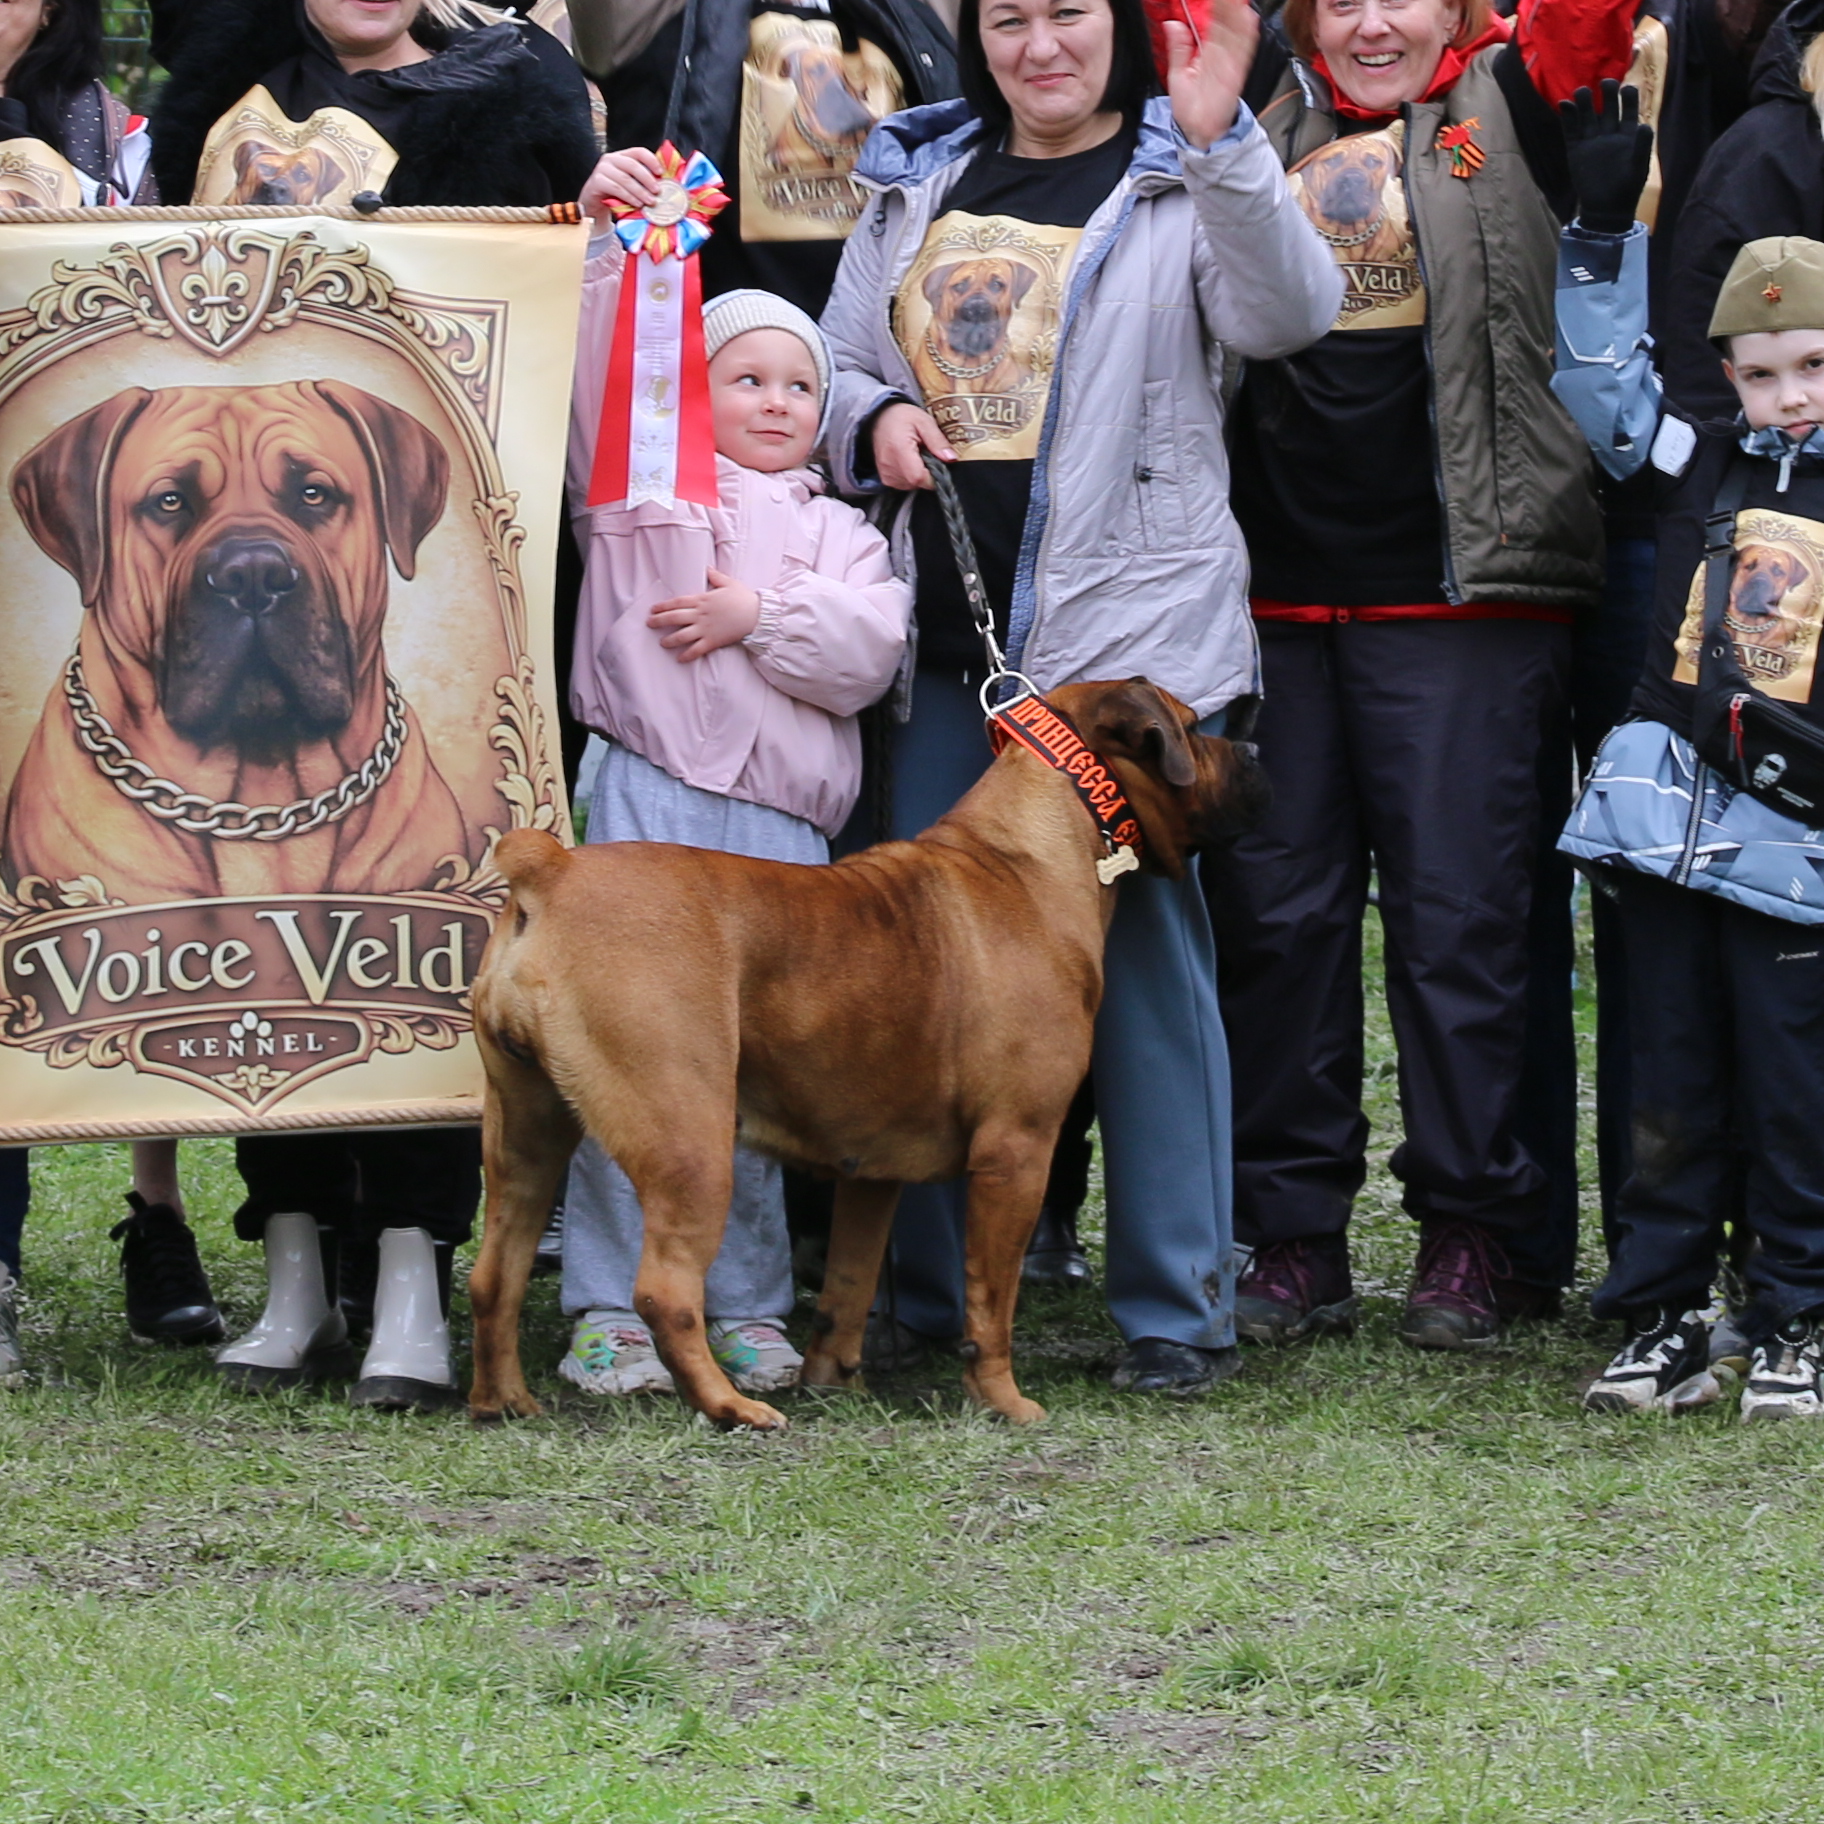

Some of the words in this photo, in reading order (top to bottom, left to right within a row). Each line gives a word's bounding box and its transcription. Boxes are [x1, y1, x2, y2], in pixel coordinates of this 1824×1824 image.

[1343, 265, 1403, 294] Veld
[962, 397, 1016, 425] Veld
[1741, 646, 1783, 672] Veld
[1007, 697, 1127, 823] ПРИНЦЕССА
[13, 927, 256, 1015] Voice
[255, 910, 471, 1006] Veld
[178, 1031, 323, 1058] KENNEL
